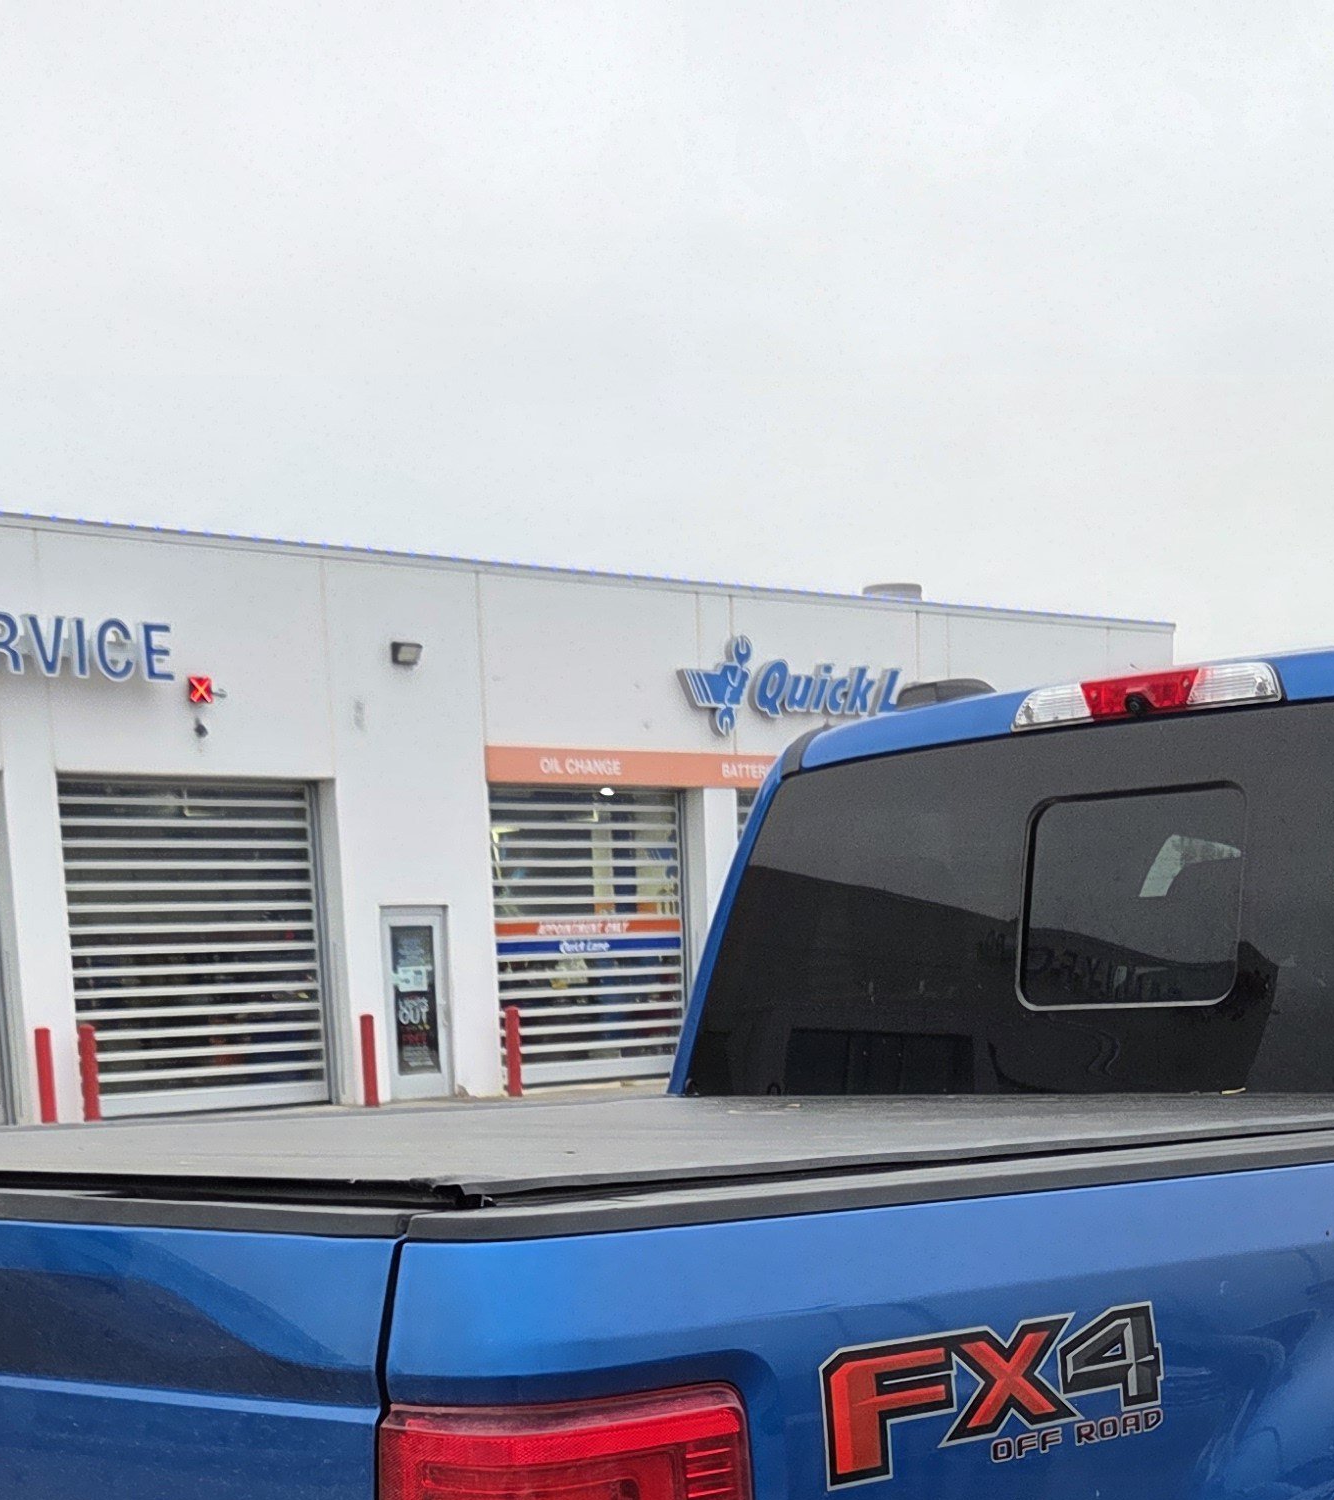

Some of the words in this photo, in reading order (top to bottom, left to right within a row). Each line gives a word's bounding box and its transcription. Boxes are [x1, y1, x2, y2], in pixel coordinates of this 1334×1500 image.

[757, 660, 877, 716] Quick
[876, 668, 900, 714] L
[540, 756, 563, 774] OIL
[565, 758, 622, 776] CHANGE
[721, 762, 771, 780] BATTER
[818, 1300, 1165, 1492] FX4
[990, 1424, 1063, 1465] OFF
[1074, 1408, 1164, 1447] ROAD
